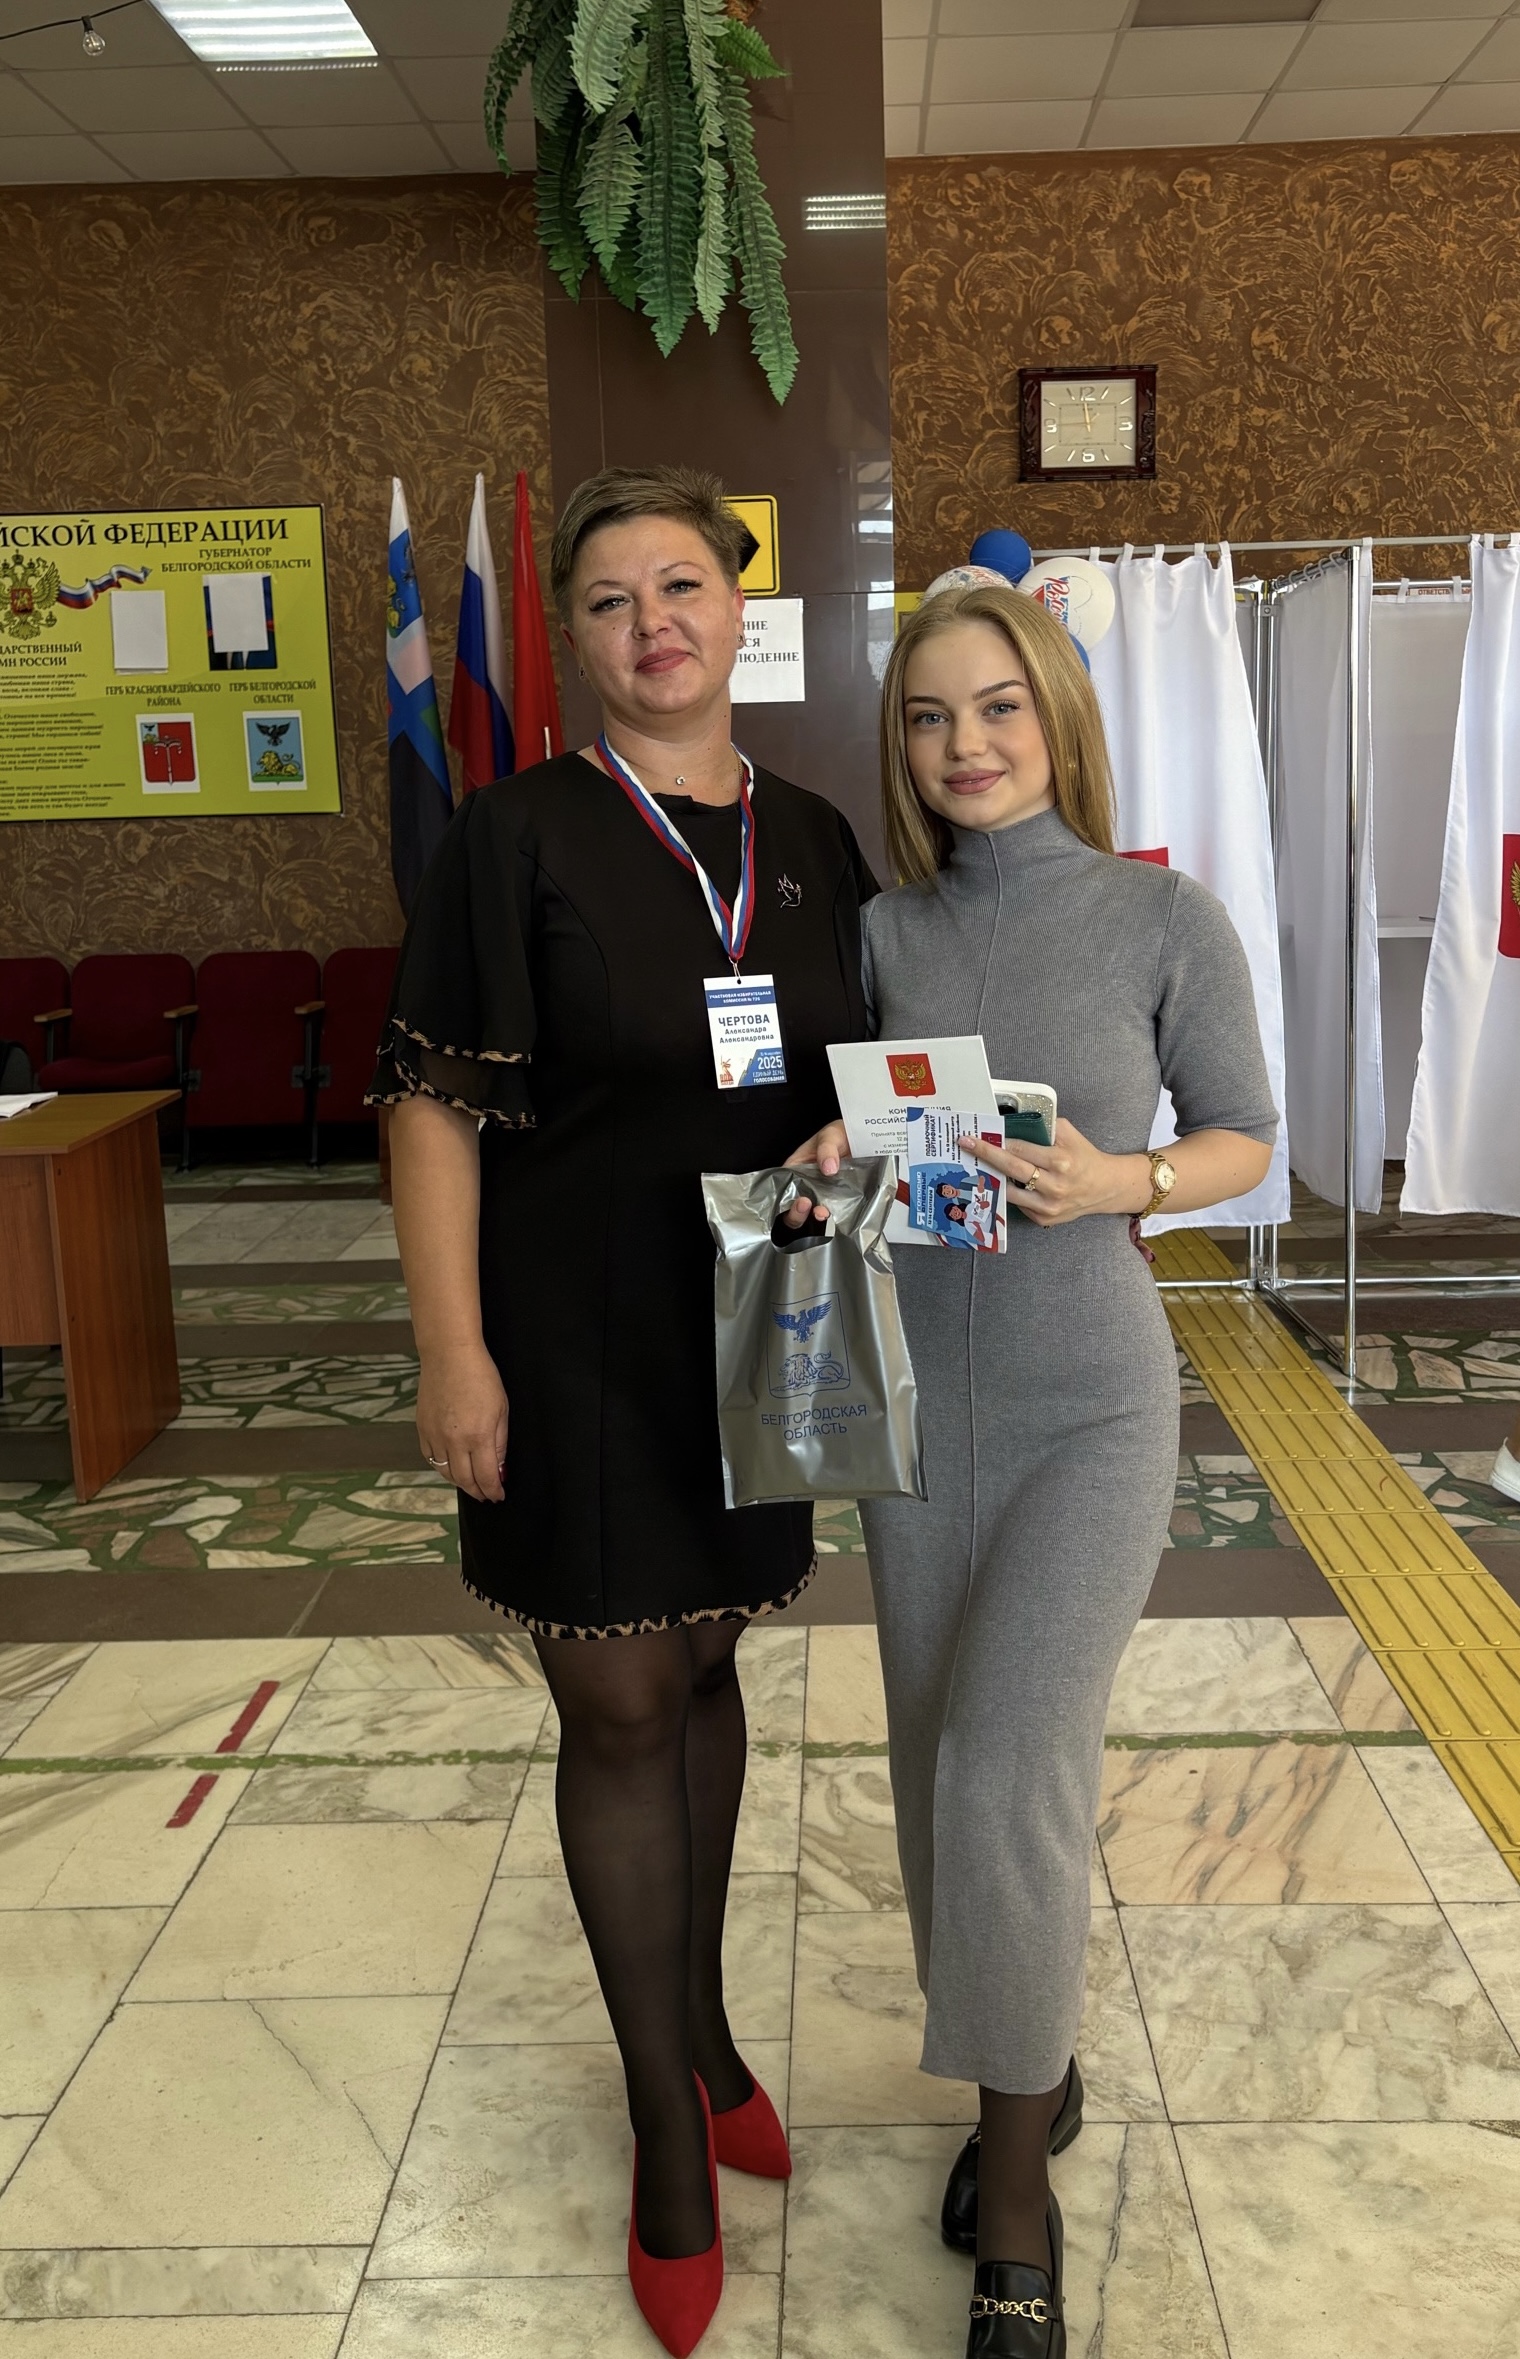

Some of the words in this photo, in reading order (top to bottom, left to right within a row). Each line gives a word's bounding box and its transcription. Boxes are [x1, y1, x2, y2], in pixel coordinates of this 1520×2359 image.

[104, 518, 289, 549] ФЕДЕРАЦИИ
[199, 547, 272, 559] ГУБЕРНАТОР
[161, 559, 253, 573] БЕЛГОРОДСКОЙ
[255, 559, 312, 570] ОБЛАСТИ
[20, 656, 67, 667] РОССИИ
[106, 685, 124, 696] ГЕРБ
[125, 682, 221, 695] КРАСНОГВАРДЕЙСКОГО
[229, 682, 248, 692] ГЕРБ
[249, 679, 317, 692] БЕЛГОРОДСКОЙ
[147, 695, 181, 707] РАЙОНА
[253, 694, 294, 704] ОБЛАСТИ
[718, 1014, 770, 1027] ЧЕРТОВА
[725, 1027, 767, 1035] Александра
[720, 1035, 774, 1044] Александровна
[757, 1055, 783, 1070] 2025
[916, 1211, 925, 1226] Я
[761, 1404, 868, 1426] БЕЛГОРОДСКАЯ
[783, 1422, 848, 1441] ОБЛАСТЬ
